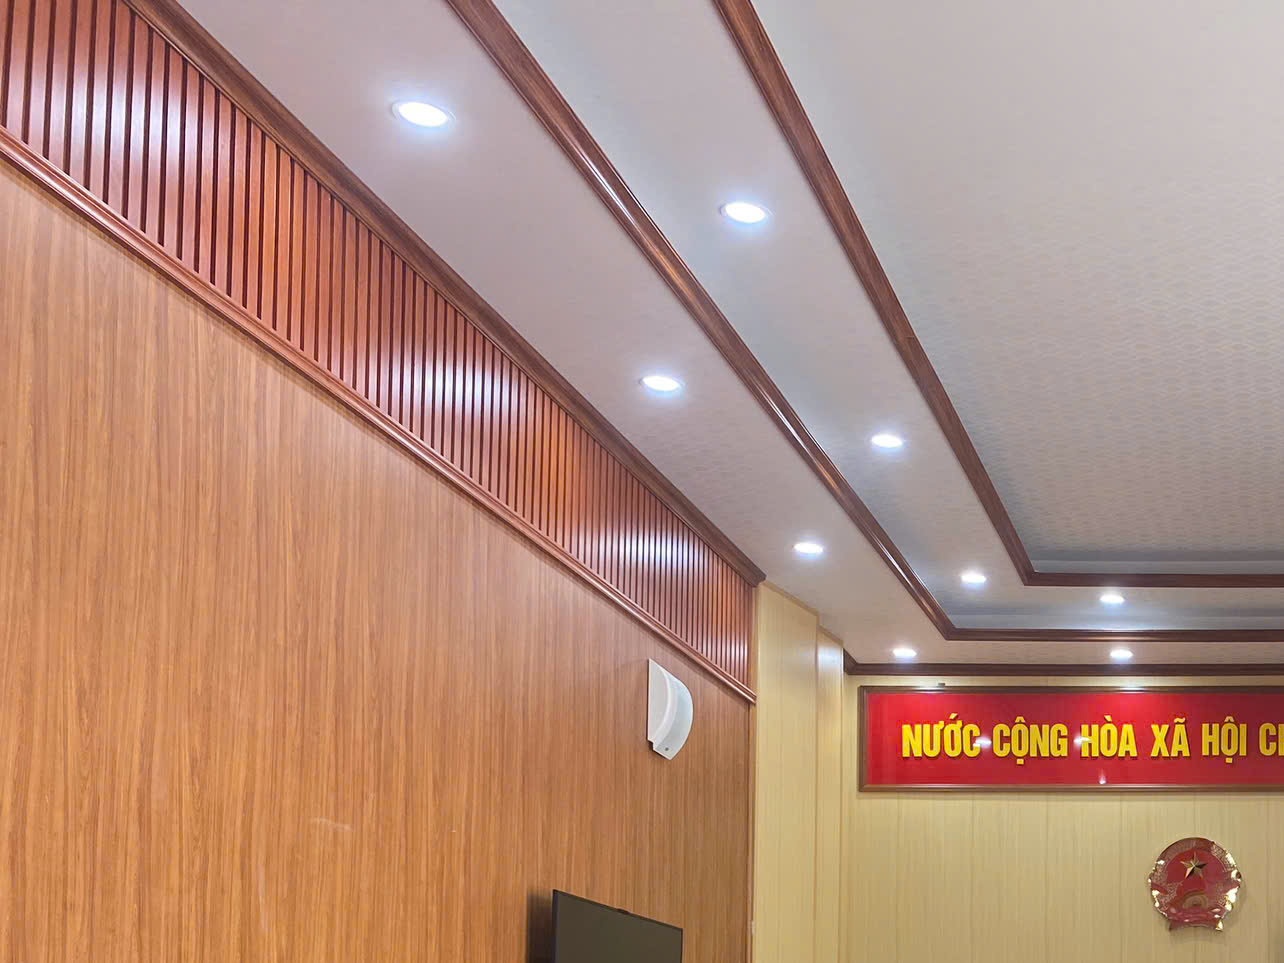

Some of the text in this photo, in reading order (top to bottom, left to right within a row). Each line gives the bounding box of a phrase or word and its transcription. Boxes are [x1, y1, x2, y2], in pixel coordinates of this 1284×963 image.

[902, 713, 981, 757] NƯỚC
[992, 716, 1068, 765] CỘNG
[1081, 715, 1138, 757] HÒA
[1150, 717, 1190, 757] XÃ
[1201, 716, 1247, 763] HỘI
